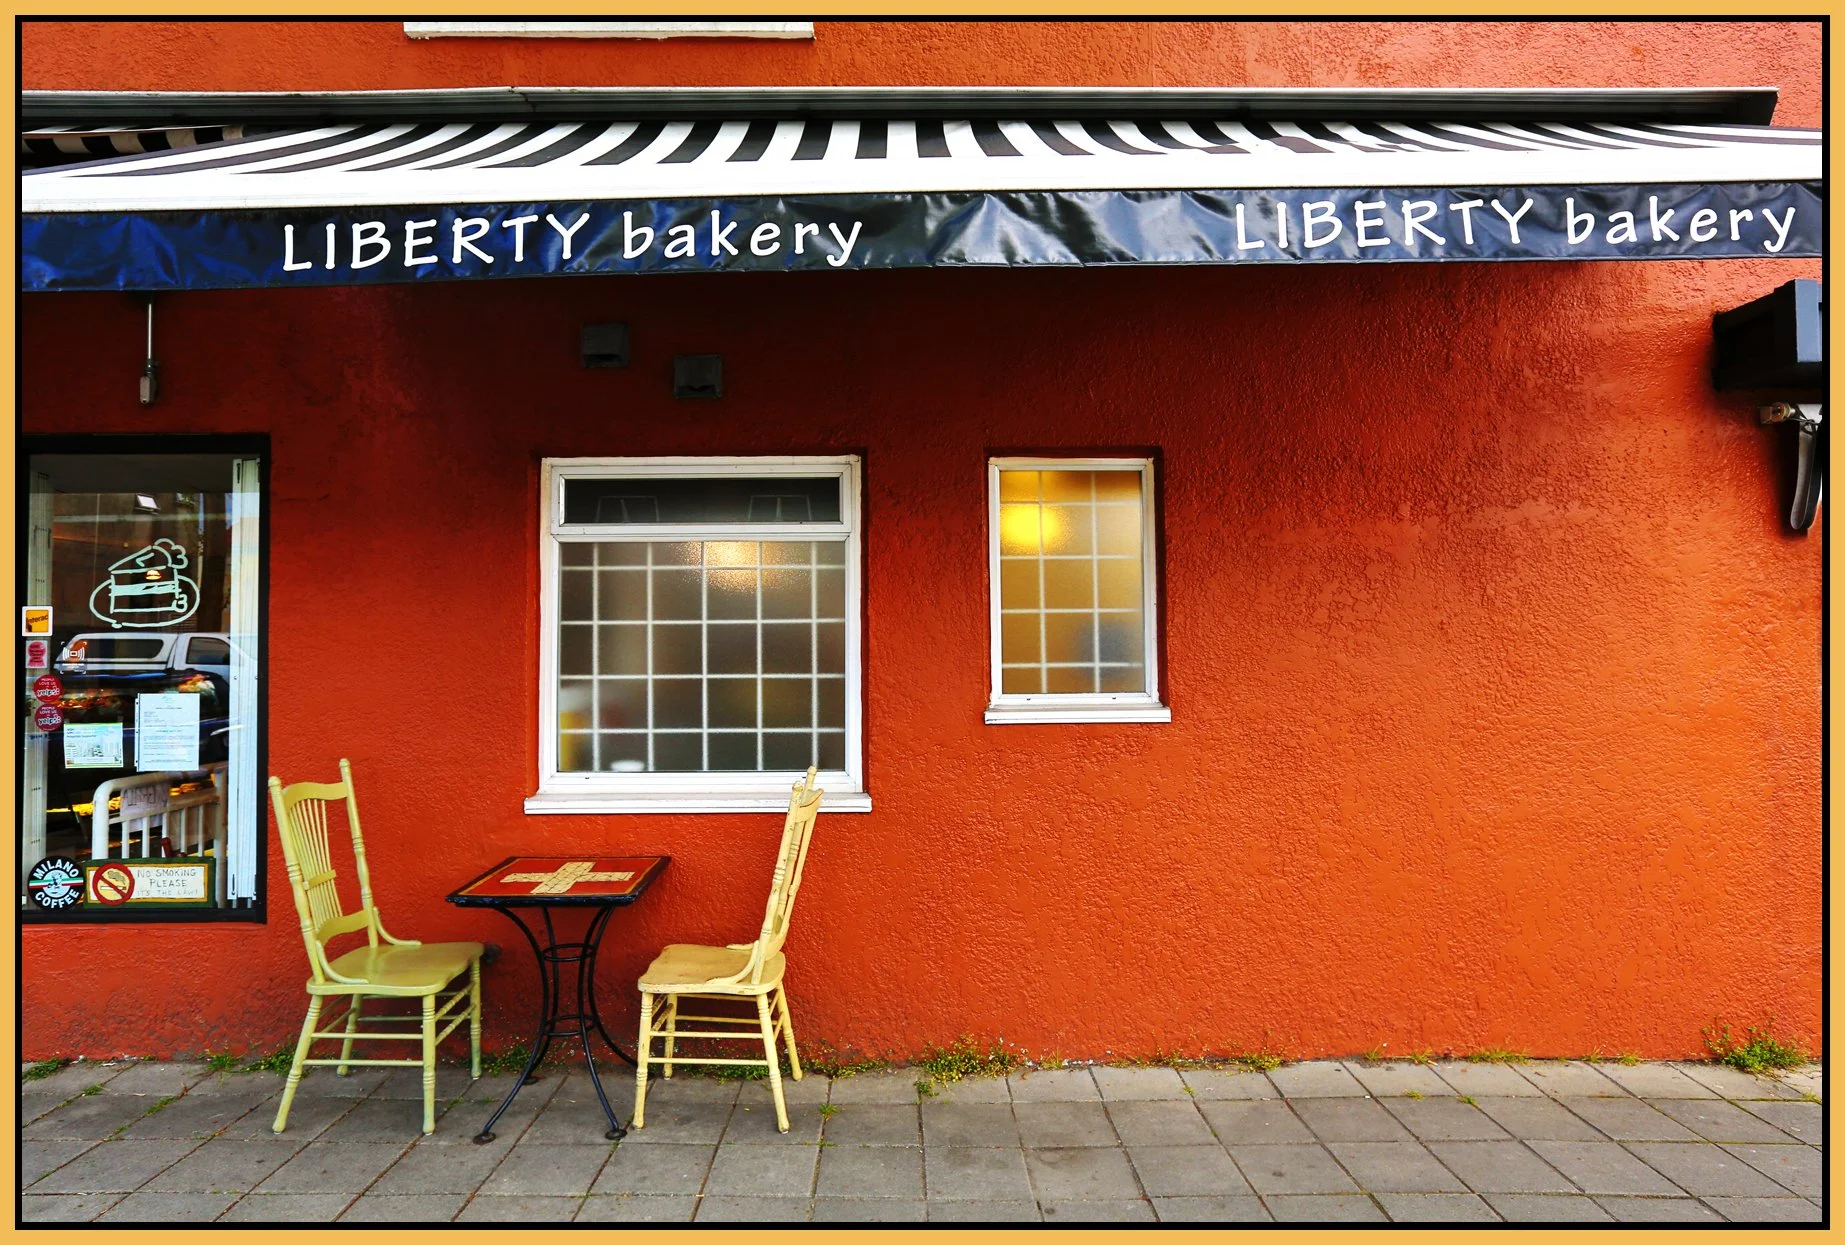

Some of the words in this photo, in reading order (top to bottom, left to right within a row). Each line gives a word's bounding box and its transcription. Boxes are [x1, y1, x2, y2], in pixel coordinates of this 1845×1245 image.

[1234, 198, 1536, 251] LIBERTY
[1565, 194, 1798, 255] bakery
[282, 212, 591, 273] LIBERTY
[622, 209, 865, 267] bakery
[33, 859, 79, 880] MILANO
[137, 869, 151, 878] NO
[149, 878, 188, 889] PLEASE
[35, 889, 80, 909] COFFEE
